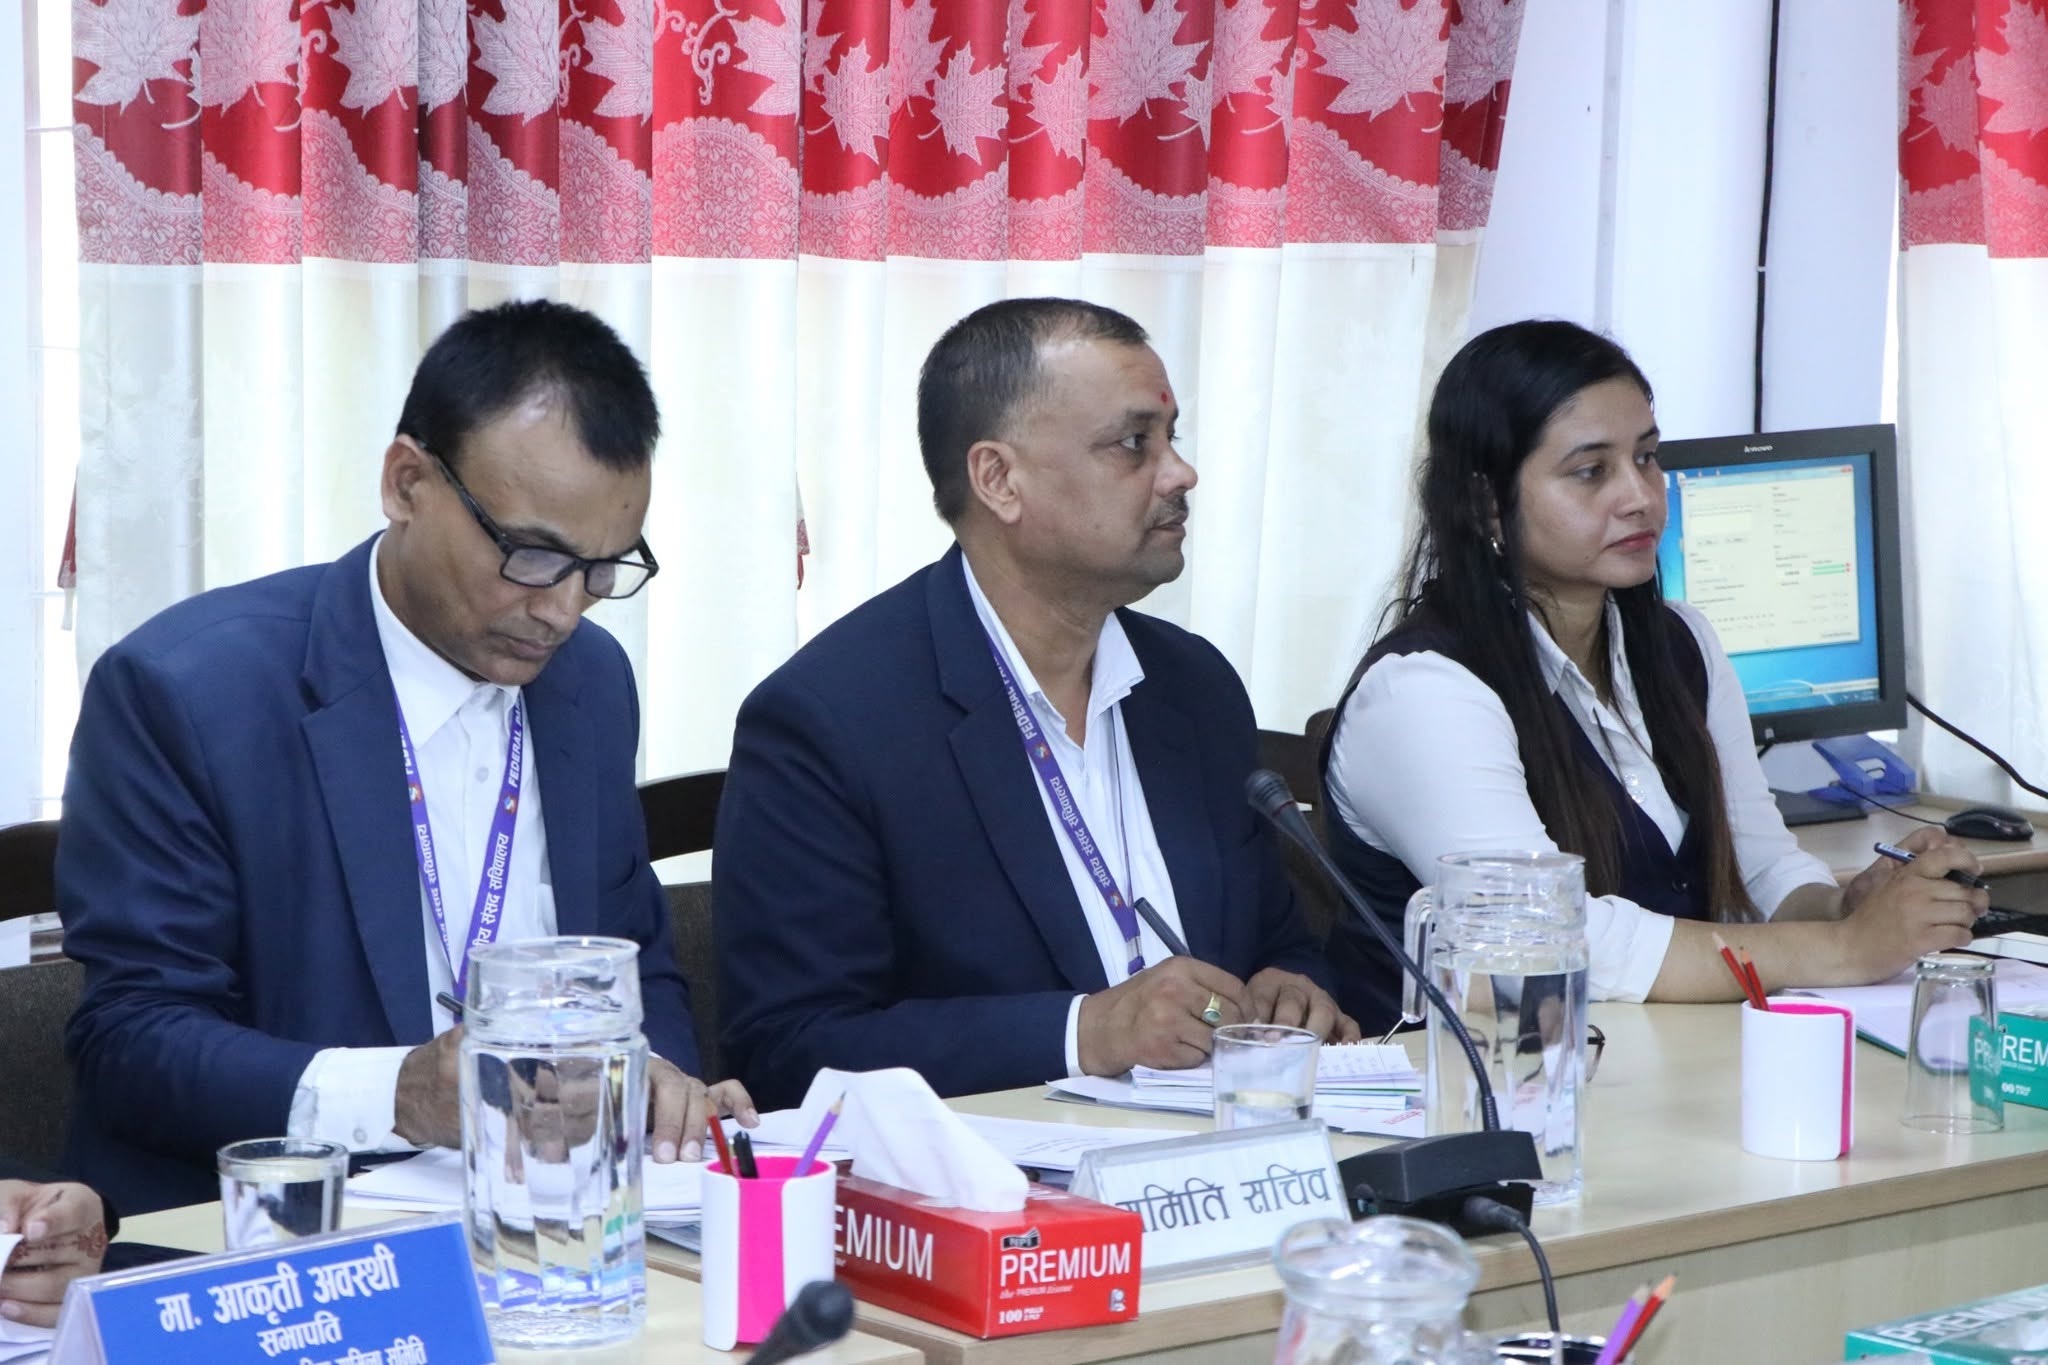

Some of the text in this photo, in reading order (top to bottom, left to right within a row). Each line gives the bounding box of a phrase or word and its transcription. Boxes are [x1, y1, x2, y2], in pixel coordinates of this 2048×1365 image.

[508, 730, 523, 788] FEDERAL
[488, 832, 509, 890] सचिवालय
[480, 892, 501, 924] संसद
[1240, 1164, 1331, 1213] सचिव
[833, 1205, 934, 1281] EMIUM
[1000, 1242, 1131, 1287] PREMIUM
[155, 1242, 400, 1332] मा. आकृती अवस्थी
[256, 1311, 342, 1357] सभापति
[998, 1309, 1022, 1324] 100
